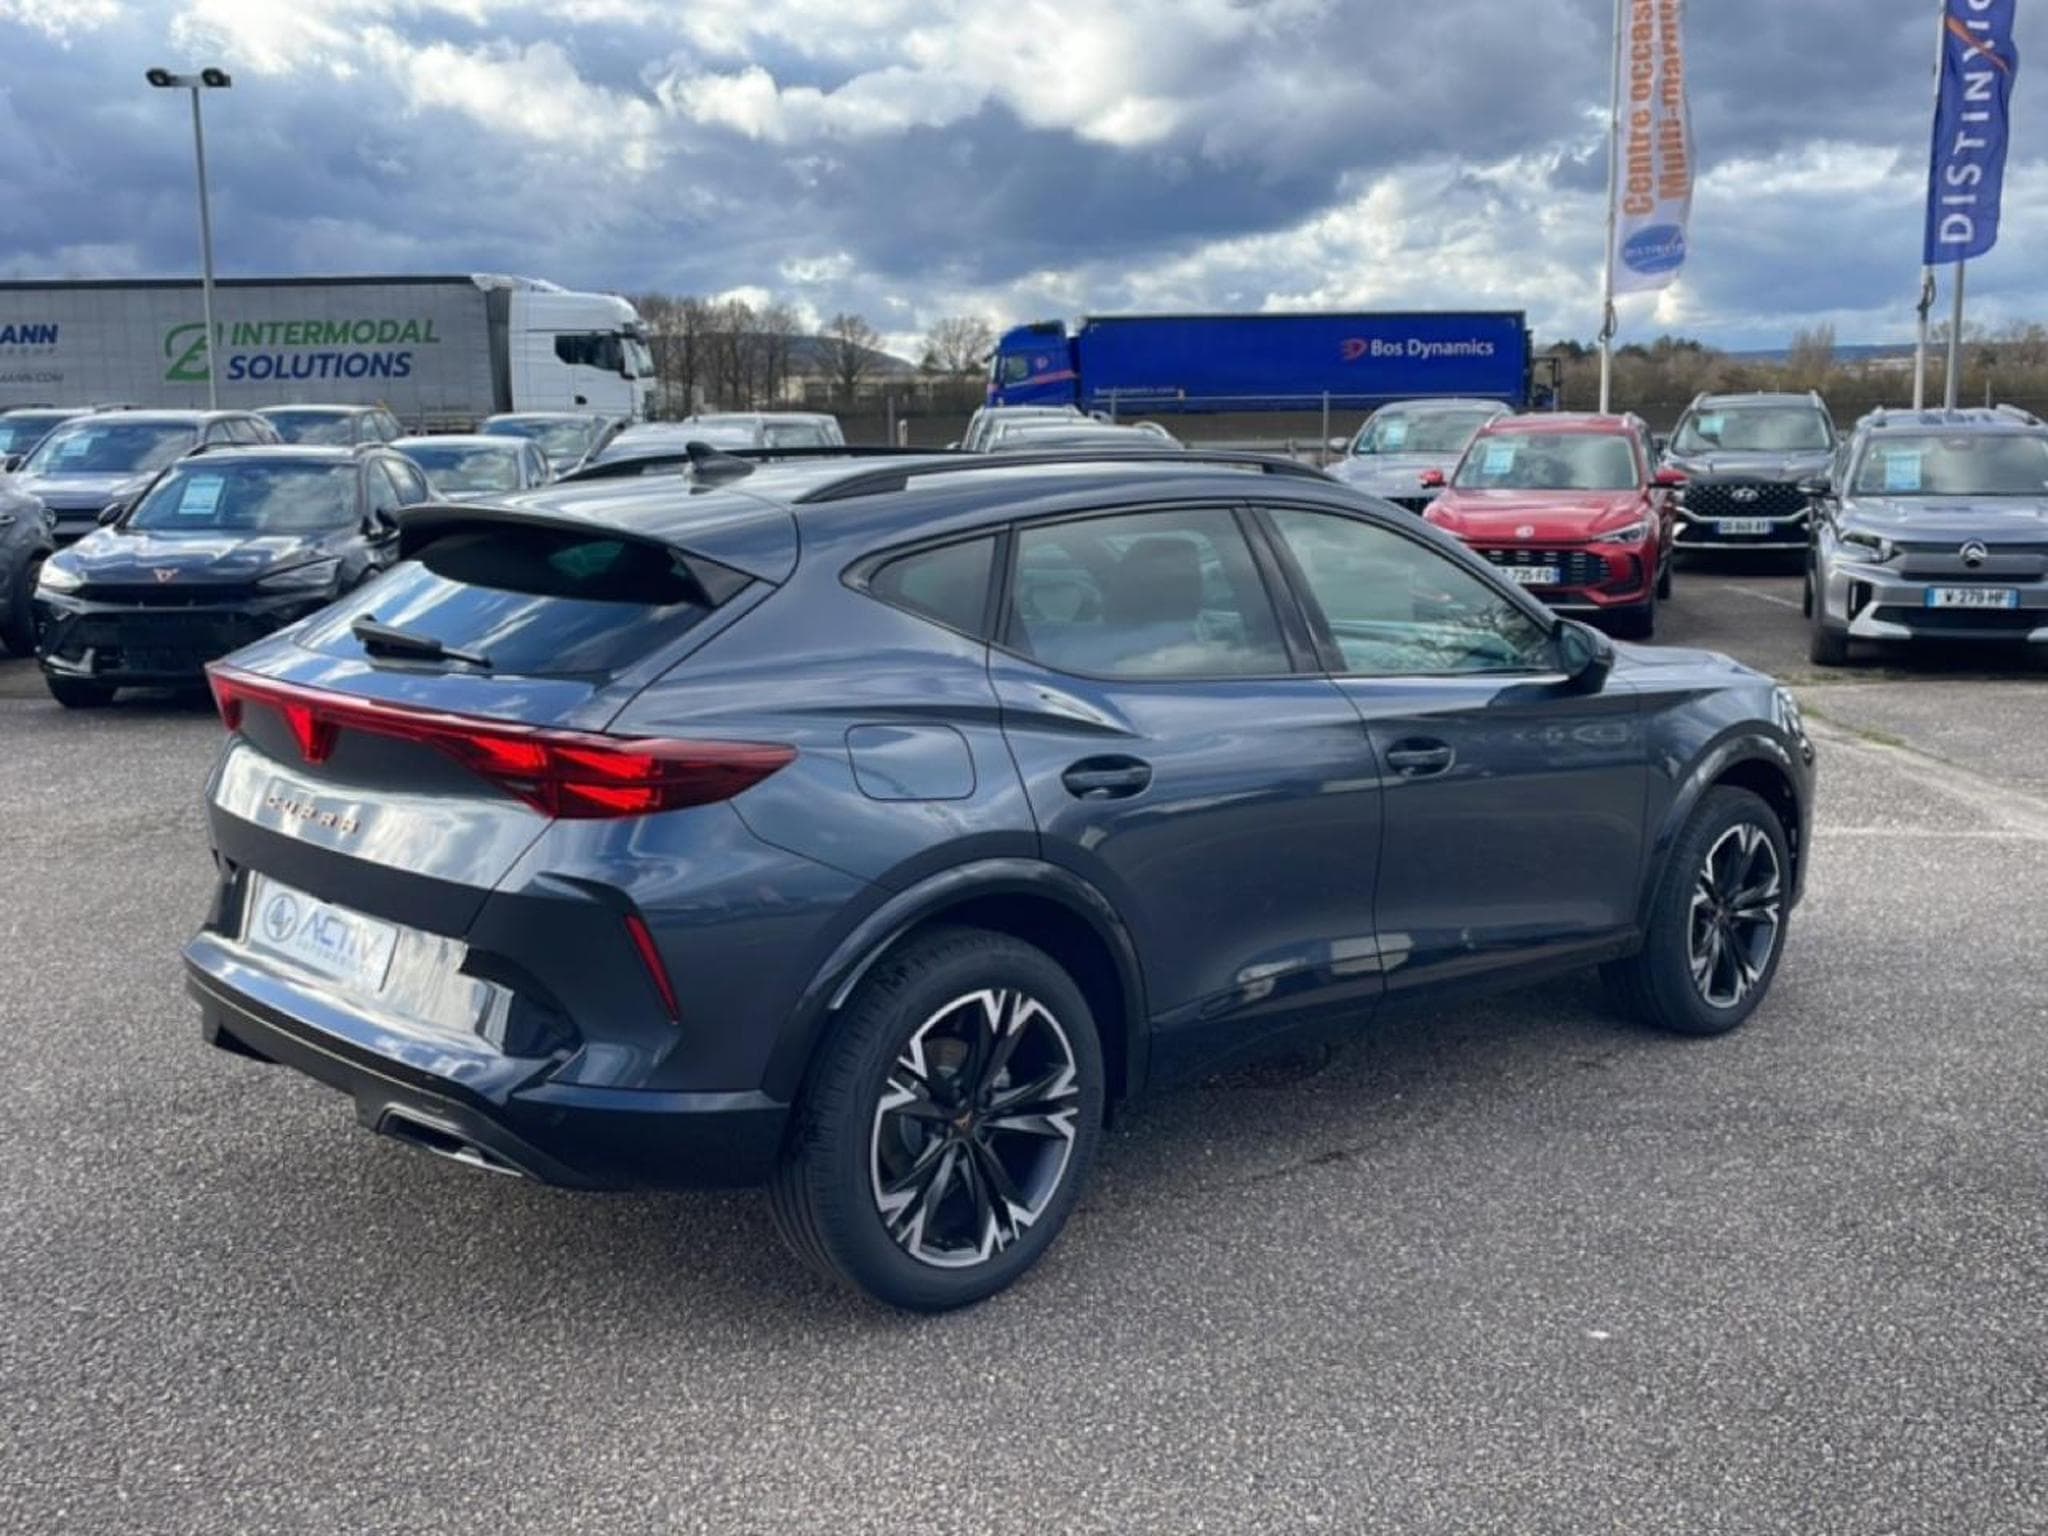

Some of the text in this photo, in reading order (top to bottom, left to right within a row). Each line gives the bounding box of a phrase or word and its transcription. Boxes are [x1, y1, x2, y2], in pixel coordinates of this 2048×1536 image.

[1623, 110, 1655, 215] Centre
[231, 318, 441, 346] INTERMODAL
[1370, 338, 1495, 359] Bos Dynamics
[227, 352, 412, 380] SOLUTIONS
